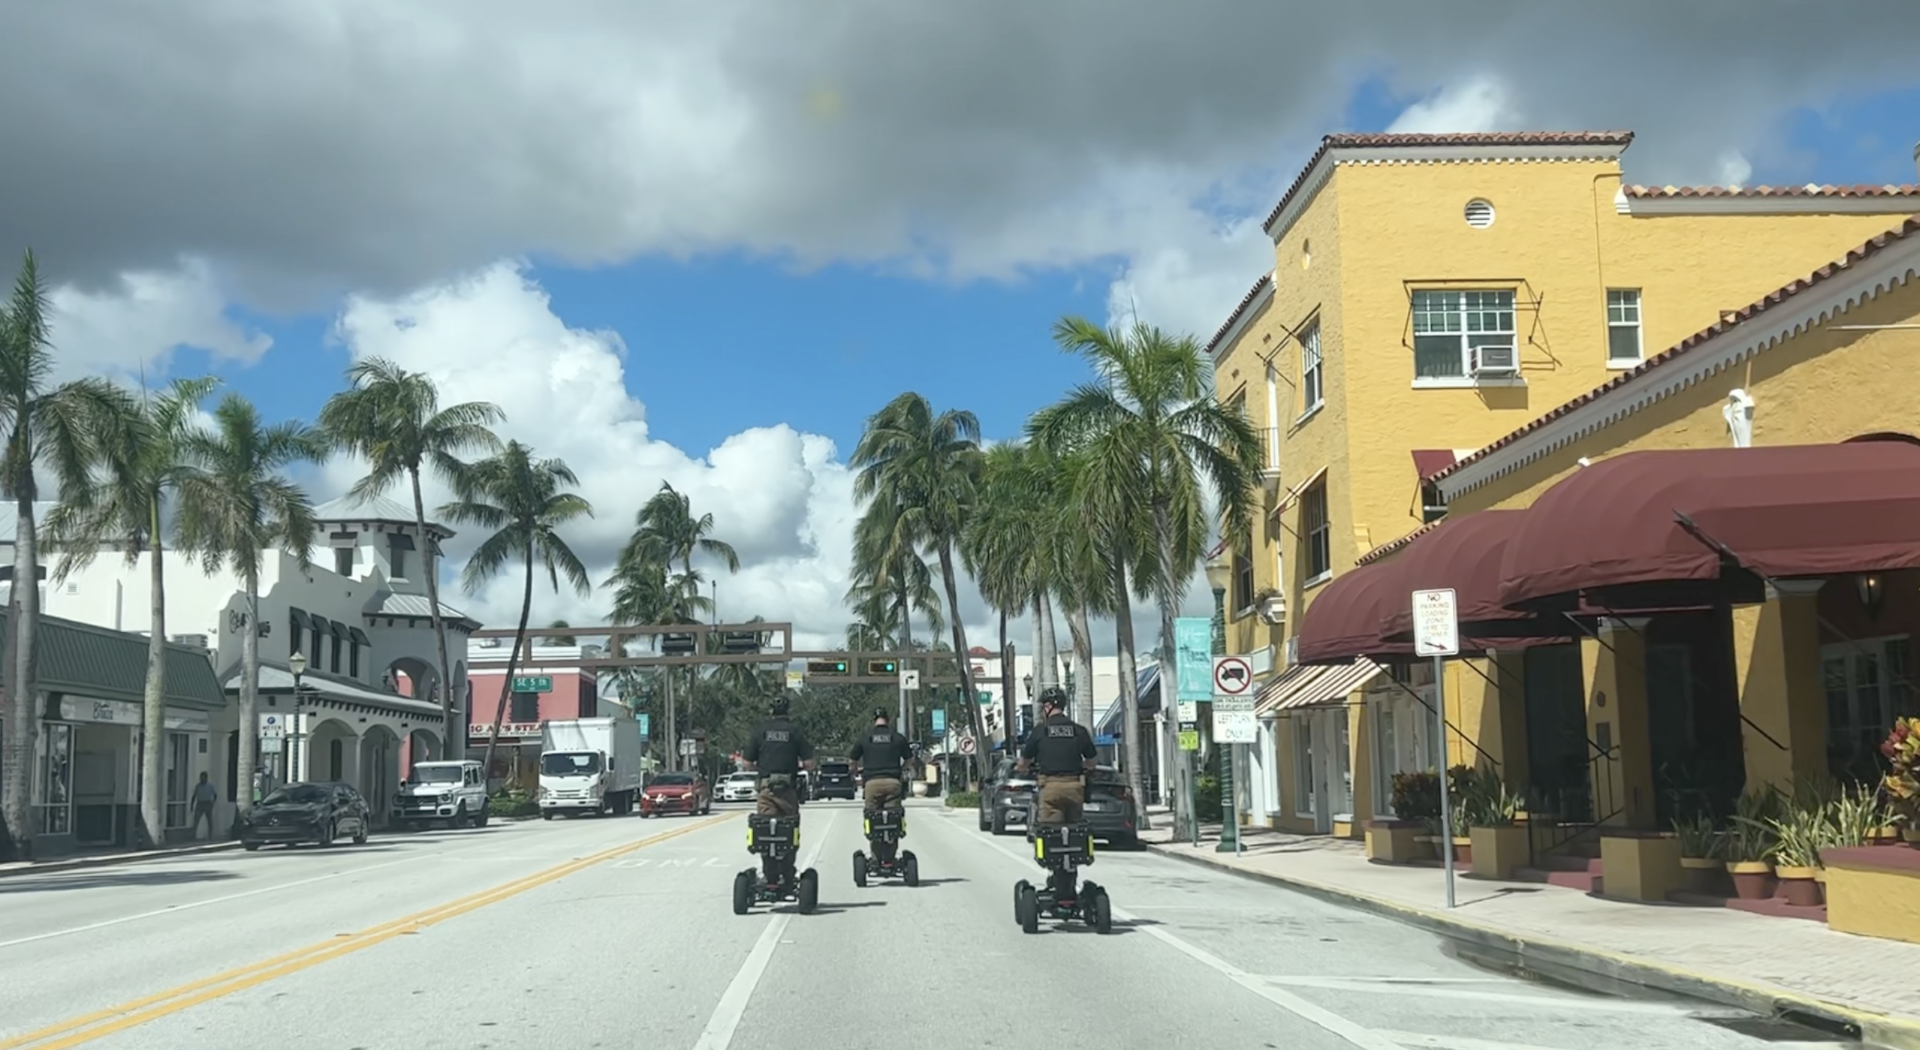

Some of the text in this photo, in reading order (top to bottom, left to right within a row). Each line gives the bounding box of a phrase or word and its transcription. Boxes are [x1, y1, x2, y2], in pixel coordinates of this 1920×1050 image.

[1427, 593, 1441, 602] NO
[517, 678, 526, 686] SE
[530, 678, 535, 686] 5
[1217, 714, 1232, 724] LEFT
[1225, 728, 1243, 739] ONLY
